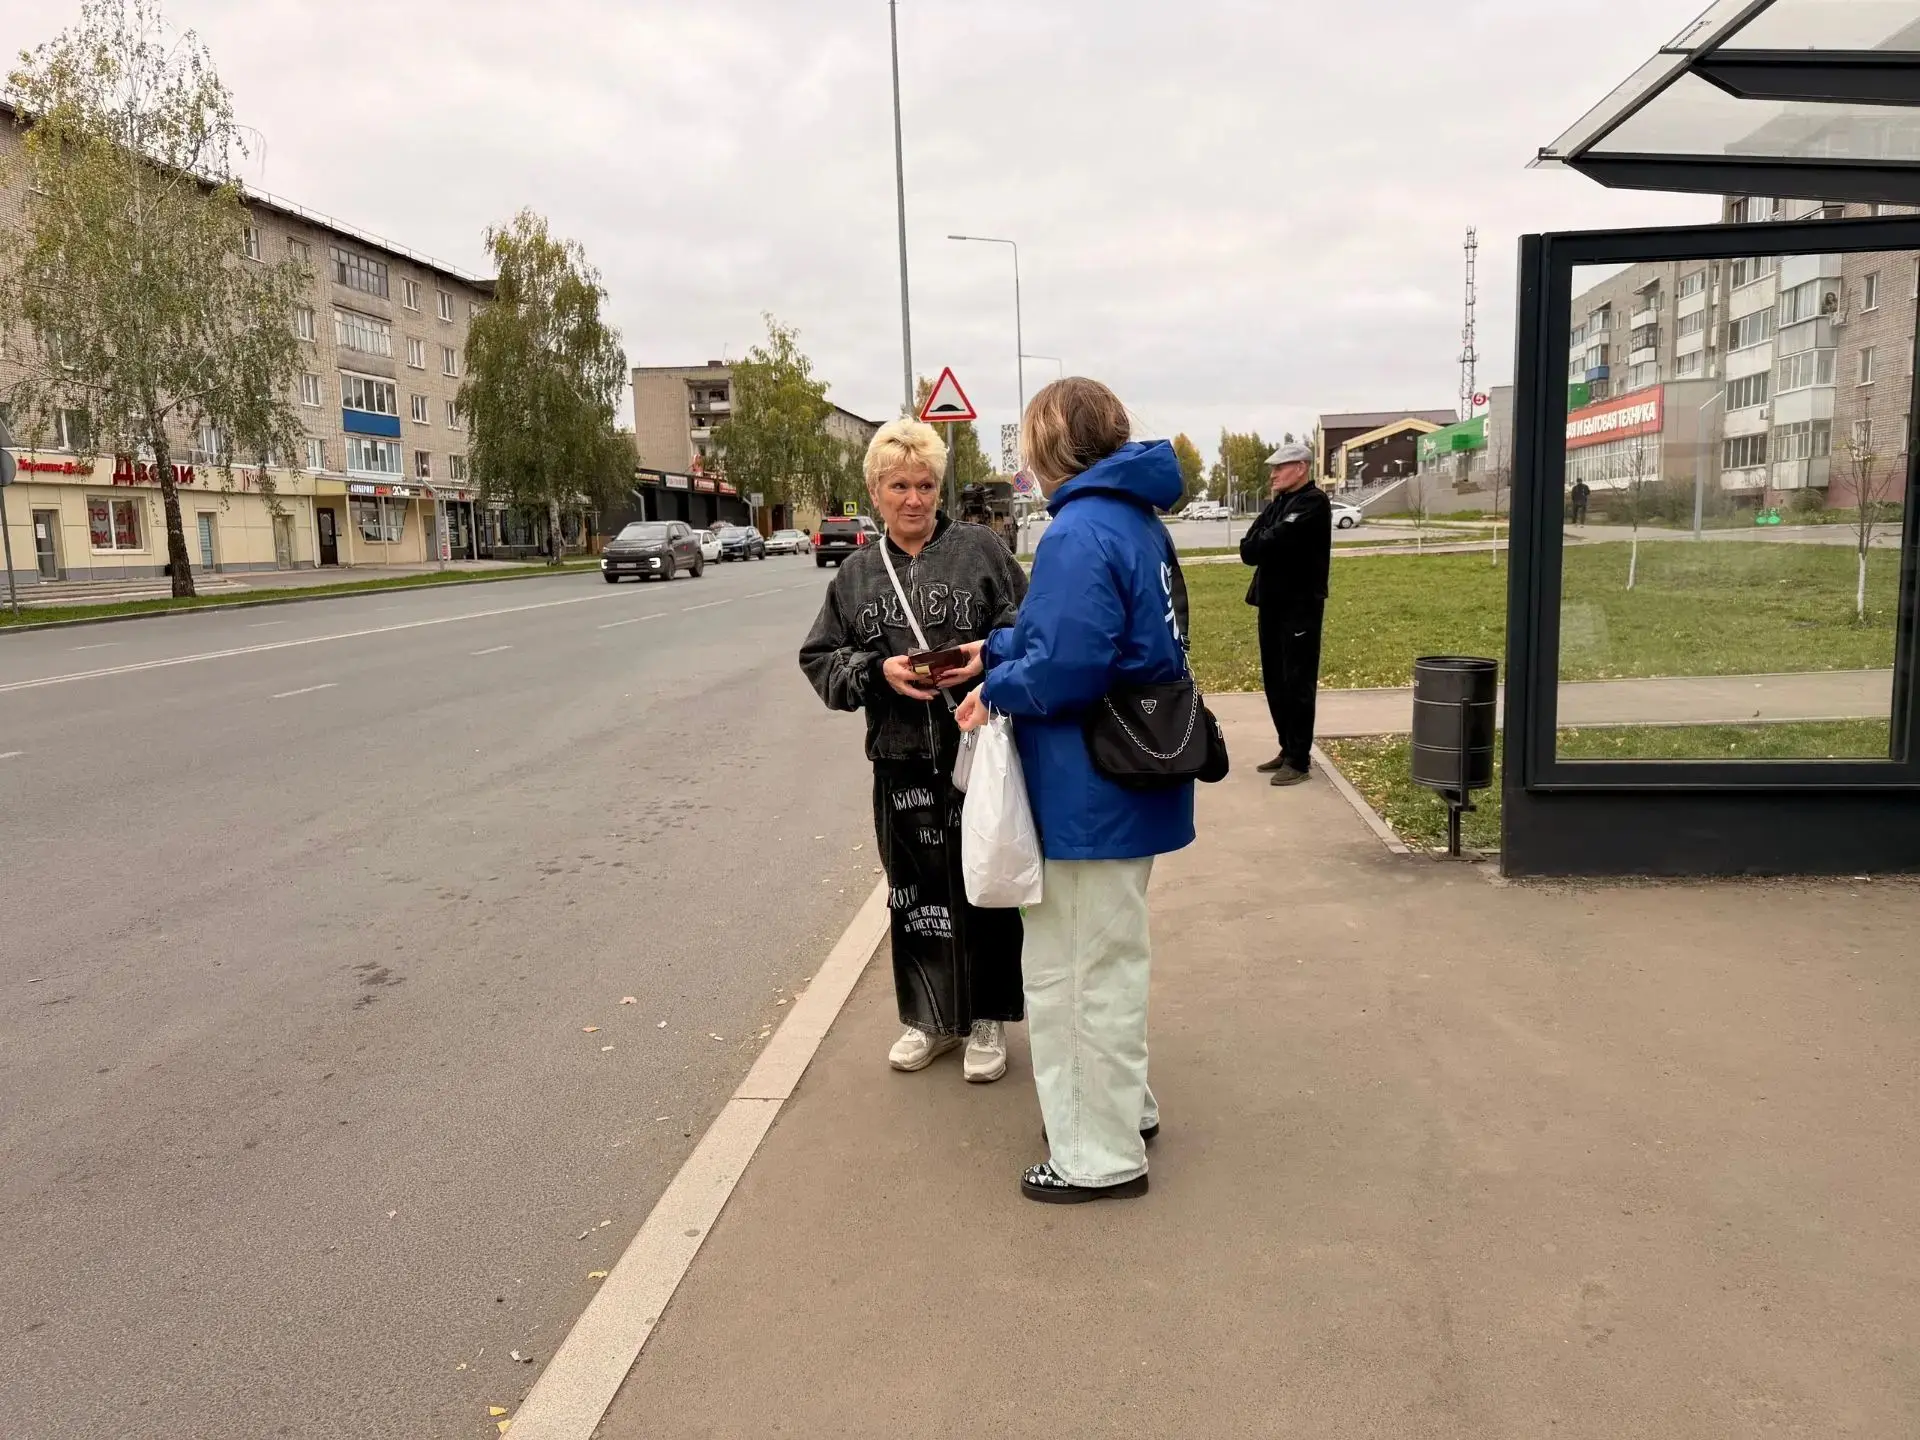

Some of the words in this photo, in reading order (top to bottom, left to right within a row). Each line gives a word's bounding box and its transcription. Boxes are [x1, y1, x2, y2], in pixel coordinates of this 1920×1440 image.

[1584, 410, 1617, 436] БЫТОВАЯ
[1618, 401, 1656, 428] ТЕХНИКА
[920, 905, 941, 917] BEAST
